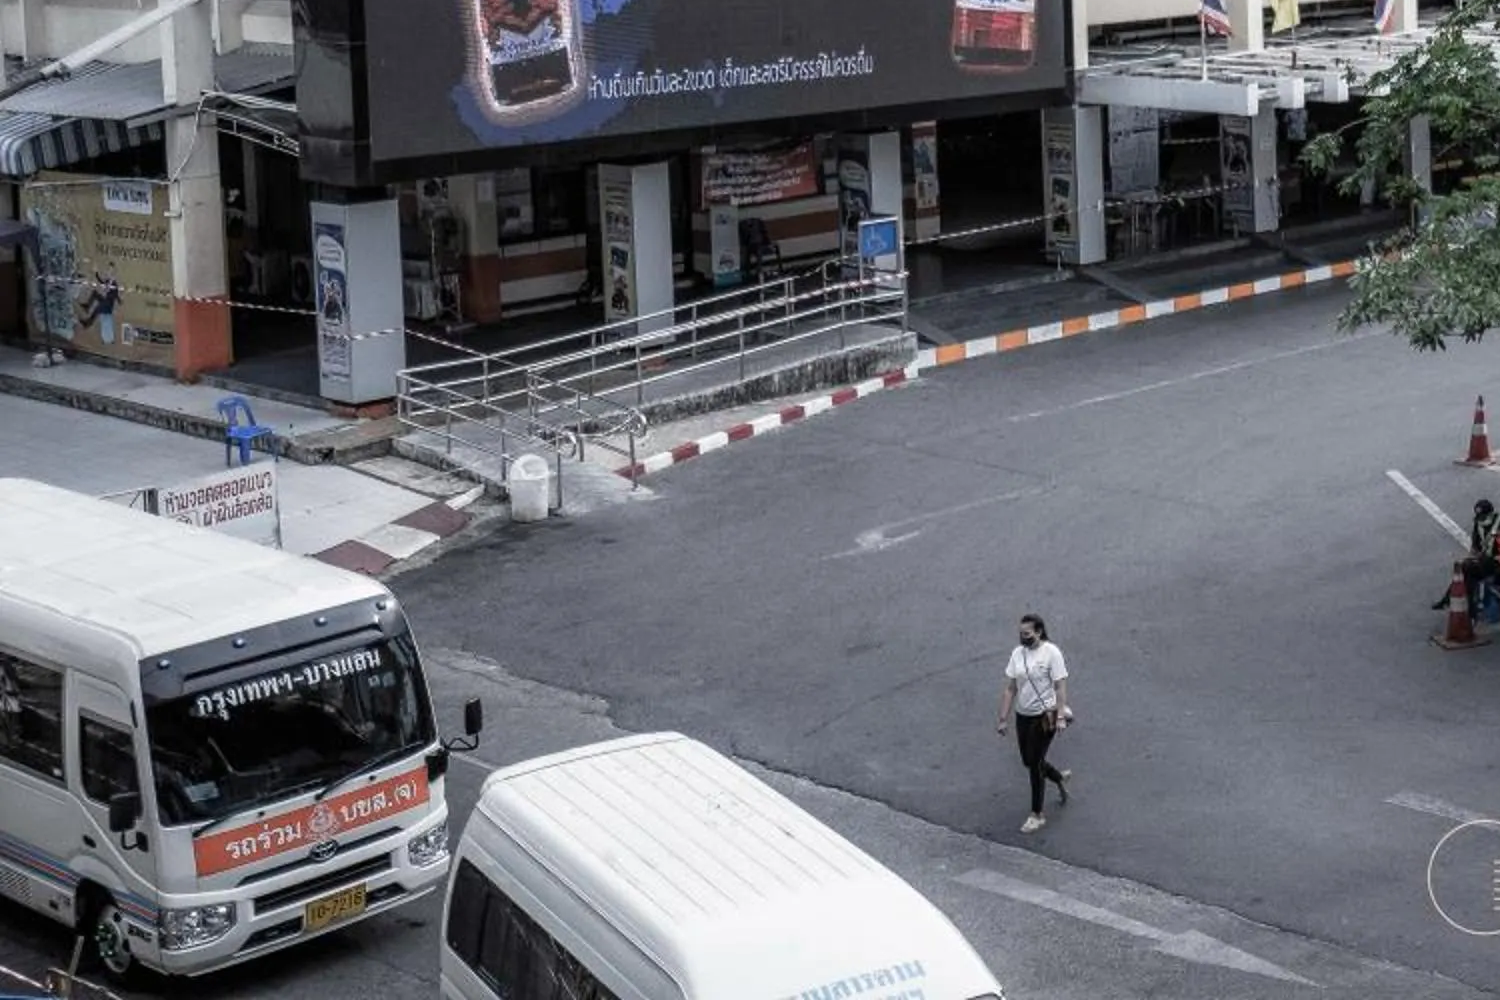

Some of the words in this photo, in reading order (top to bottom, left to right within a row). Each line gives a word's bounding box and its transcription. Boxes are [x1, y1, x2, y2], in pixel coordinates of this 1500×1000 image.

[197, 650, 381, 721] กรุงเทพฯ-บางแสน
[226, 823, 301, 860] รถร่วม
